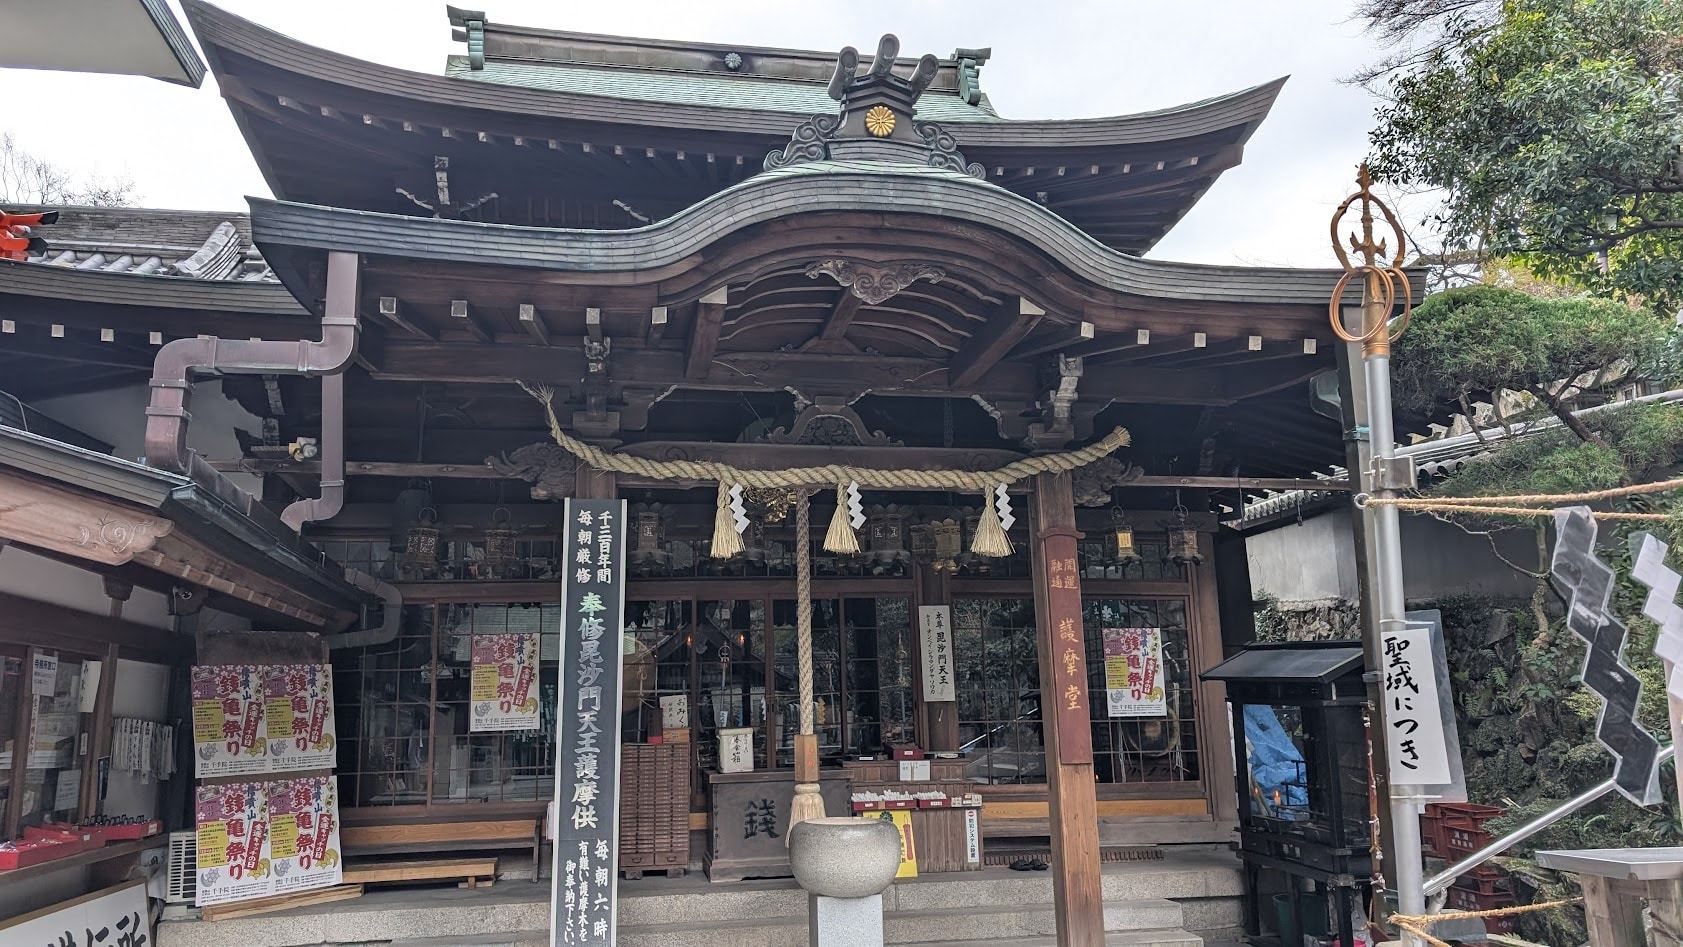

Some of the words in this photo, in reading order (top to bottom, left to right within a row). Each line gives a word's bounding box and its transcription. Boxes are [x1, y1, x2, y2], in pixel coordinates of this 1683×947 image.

[576, 509, 593, 584] 毎朝厳修
[597, 510, 613, 585] 千三百年間
[571, 592, 607, 830] 奉修毘沙門天王護摩供
[1059, 618, 1082, 710] 護摩堂
[1384, 636, 1419, 770] 聖域につき
[593, 839, 610, 940] 毎朝六時
